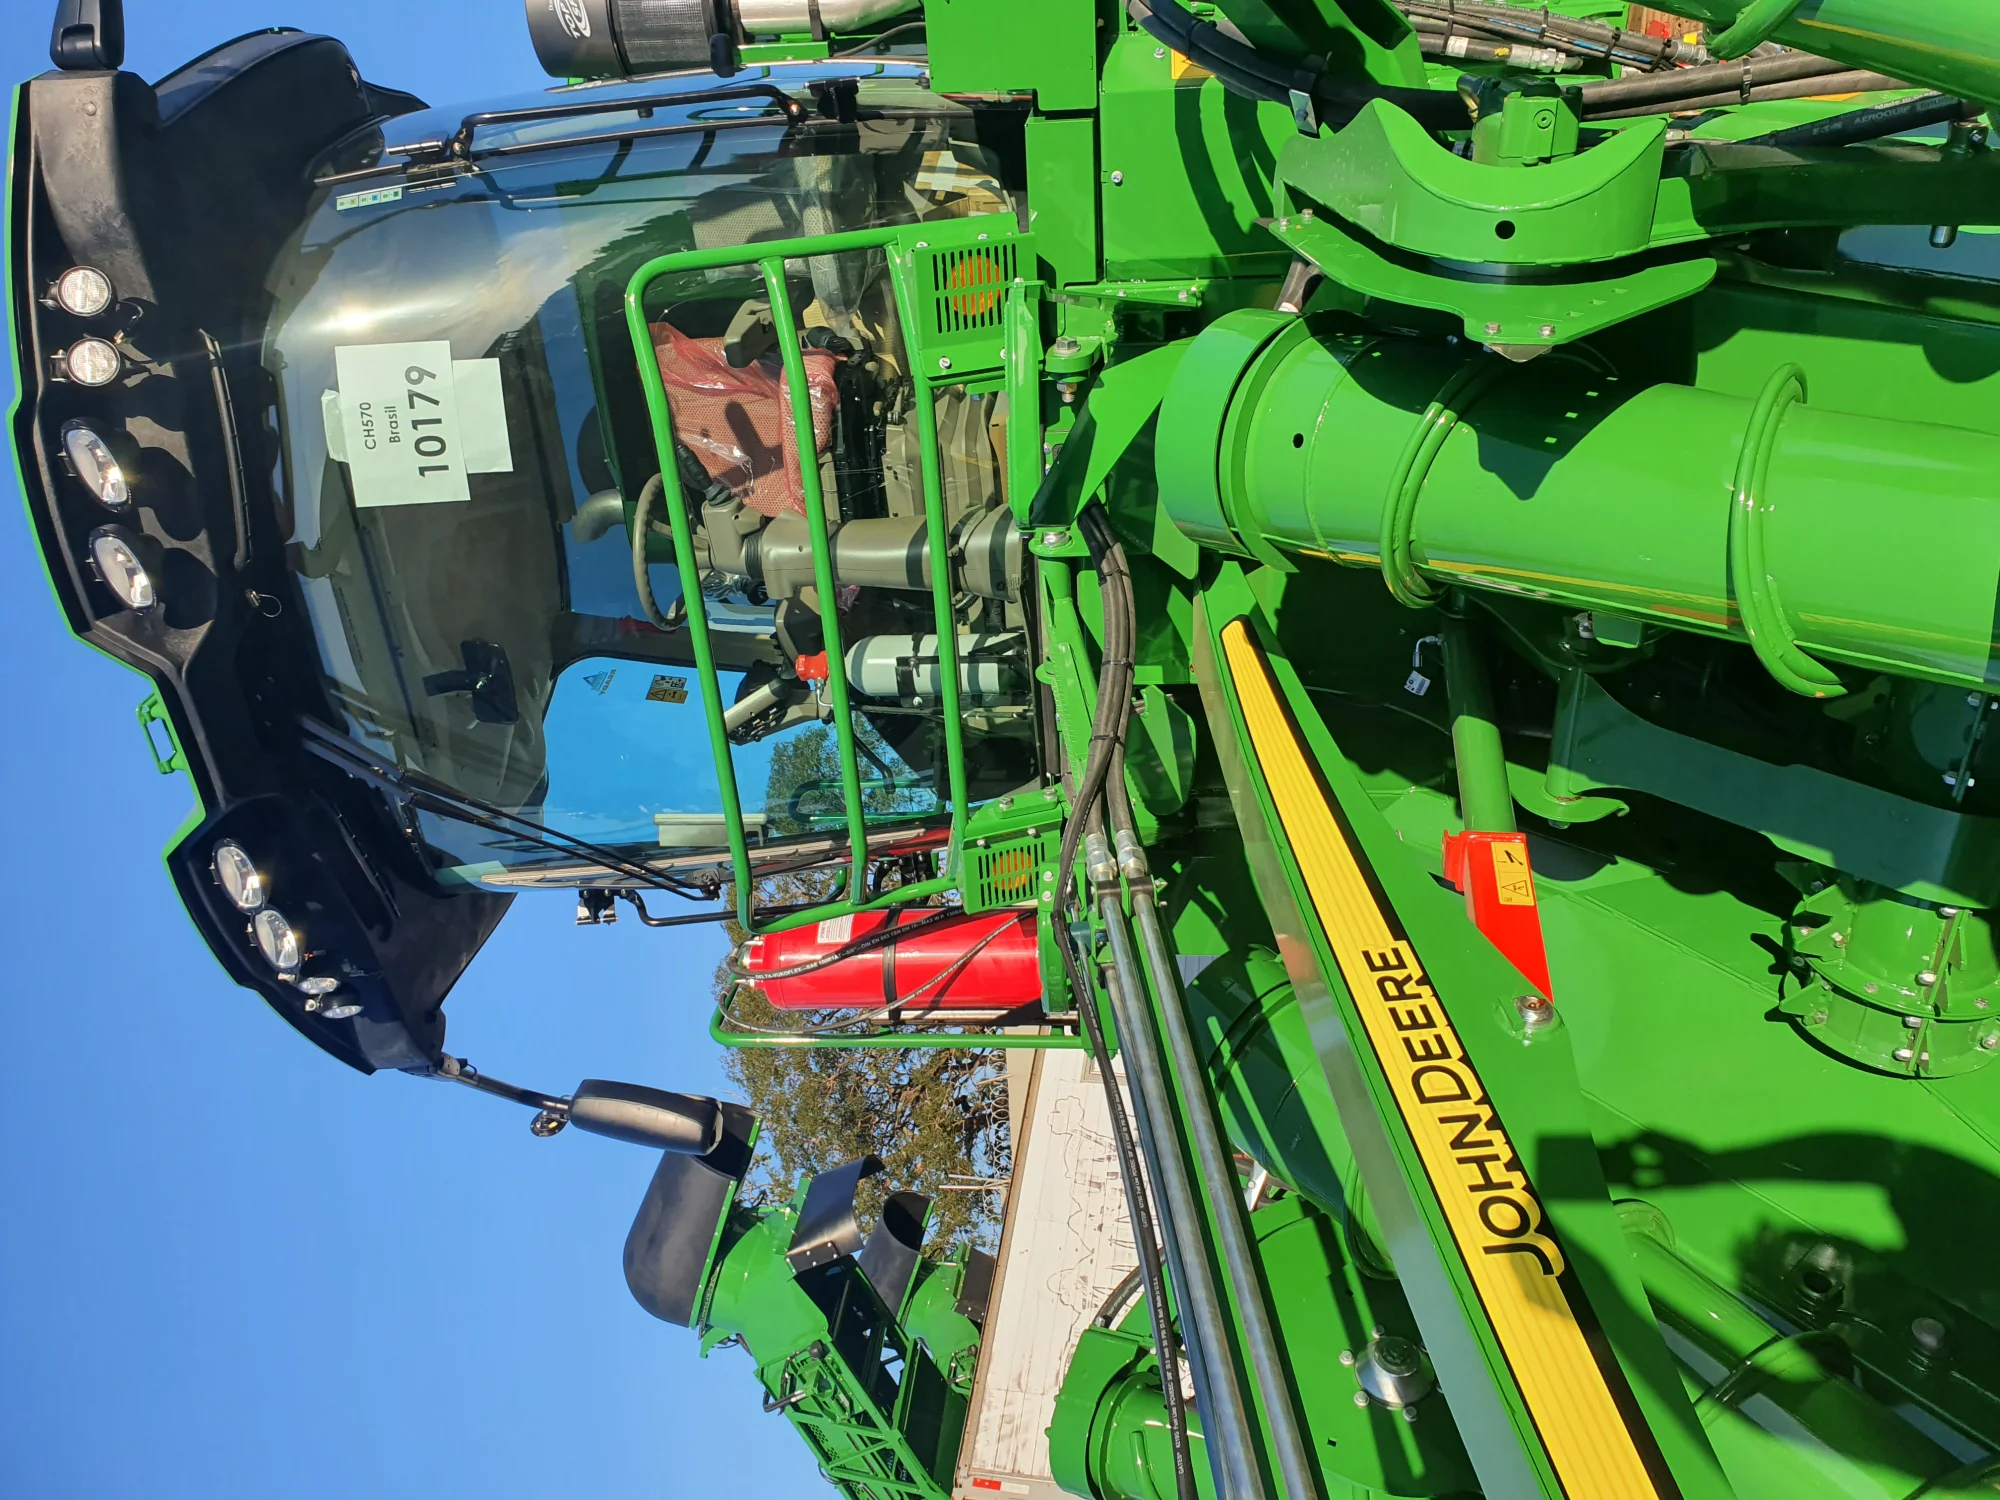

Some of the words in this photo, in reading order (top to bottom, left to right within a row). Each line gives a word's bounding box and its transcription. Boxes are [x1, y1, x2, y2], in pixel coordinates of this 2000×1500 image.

[560, 2, 581, 39] TOP
[359, 402, 377, 450] CH570
[384, 406, 401, 444] Brasil
[404, 366, 450, 478] 10179
[1361, 948, 1472, 1104] DEERE
[1437, 1114, 1555, 1276] JOHN
